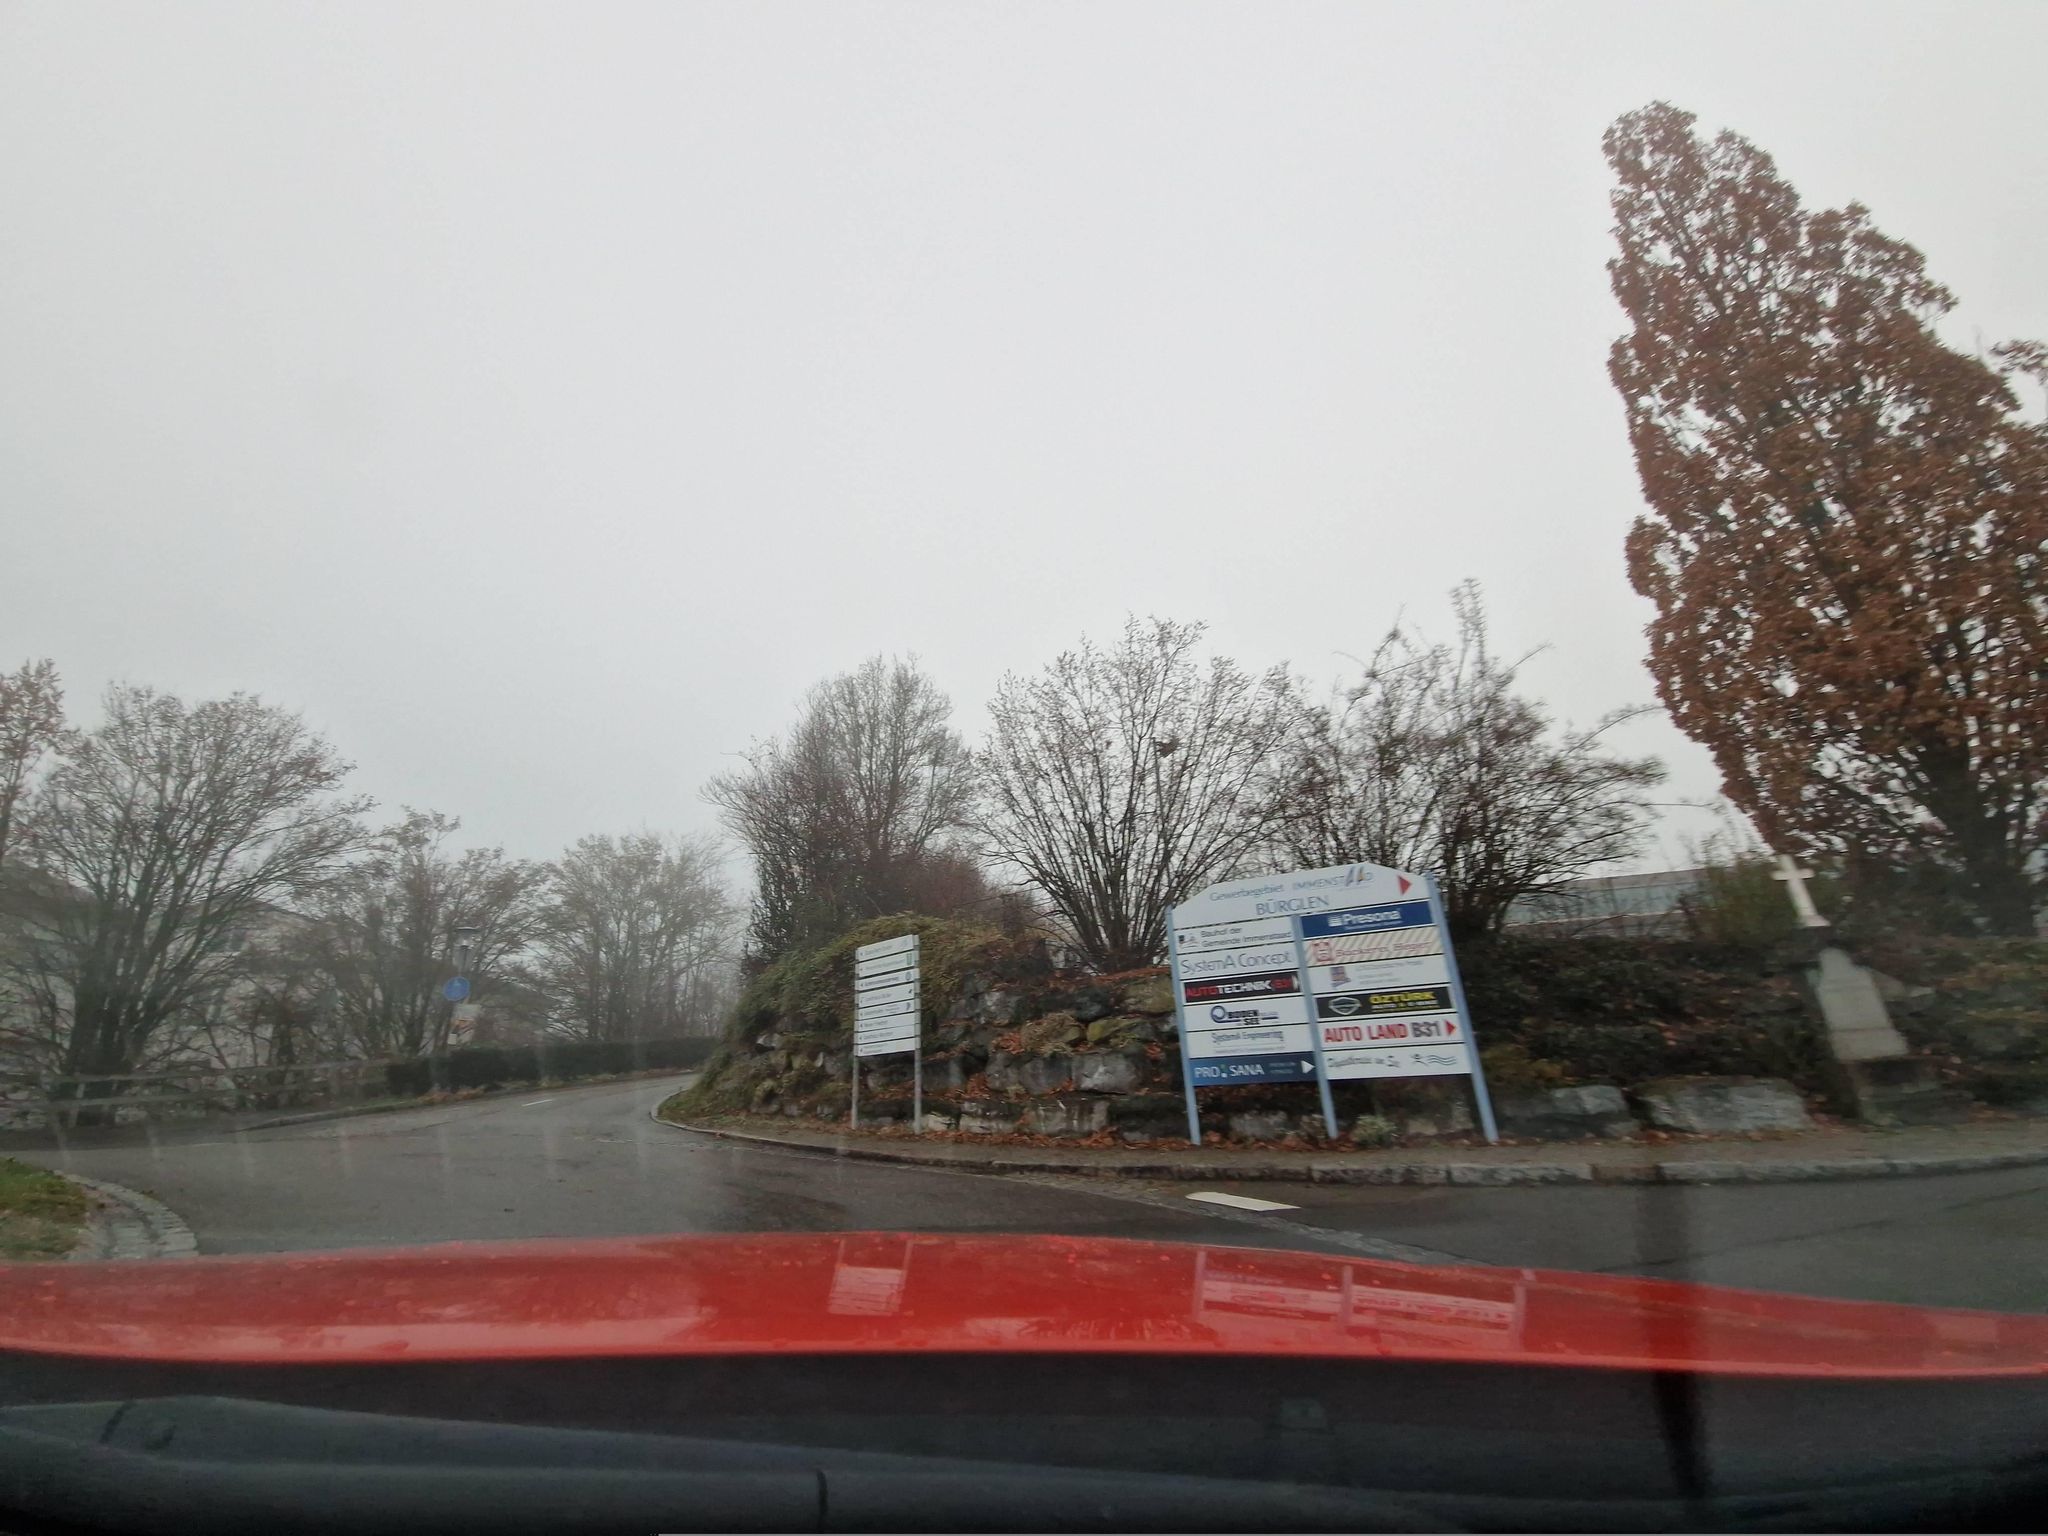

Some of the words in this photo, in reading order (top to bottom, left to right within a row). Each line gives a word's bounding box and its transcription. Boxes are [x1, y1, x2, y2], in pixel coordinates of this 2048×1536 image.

[1210, 884, 1284, 901] Gewerbegebiet
[1256, 894, 1329, 915] BÜRGLEN
[1342, 910, 1402, 925] Presona
[1201, 928, 1228, 938] Bauhof
[1230, 926, 1243, 935] der
[1202, 938, 1241, 948] Gemeinde
[1238, 950, 1293, 968] Concept
[1324, 1026, 1363, 1043] AUTO
[1368, 1023, 1409, 1040] LAND
[1411, 1021, 1441, 1038] B31
[1229, 1063, 1265, 1078] SANA
